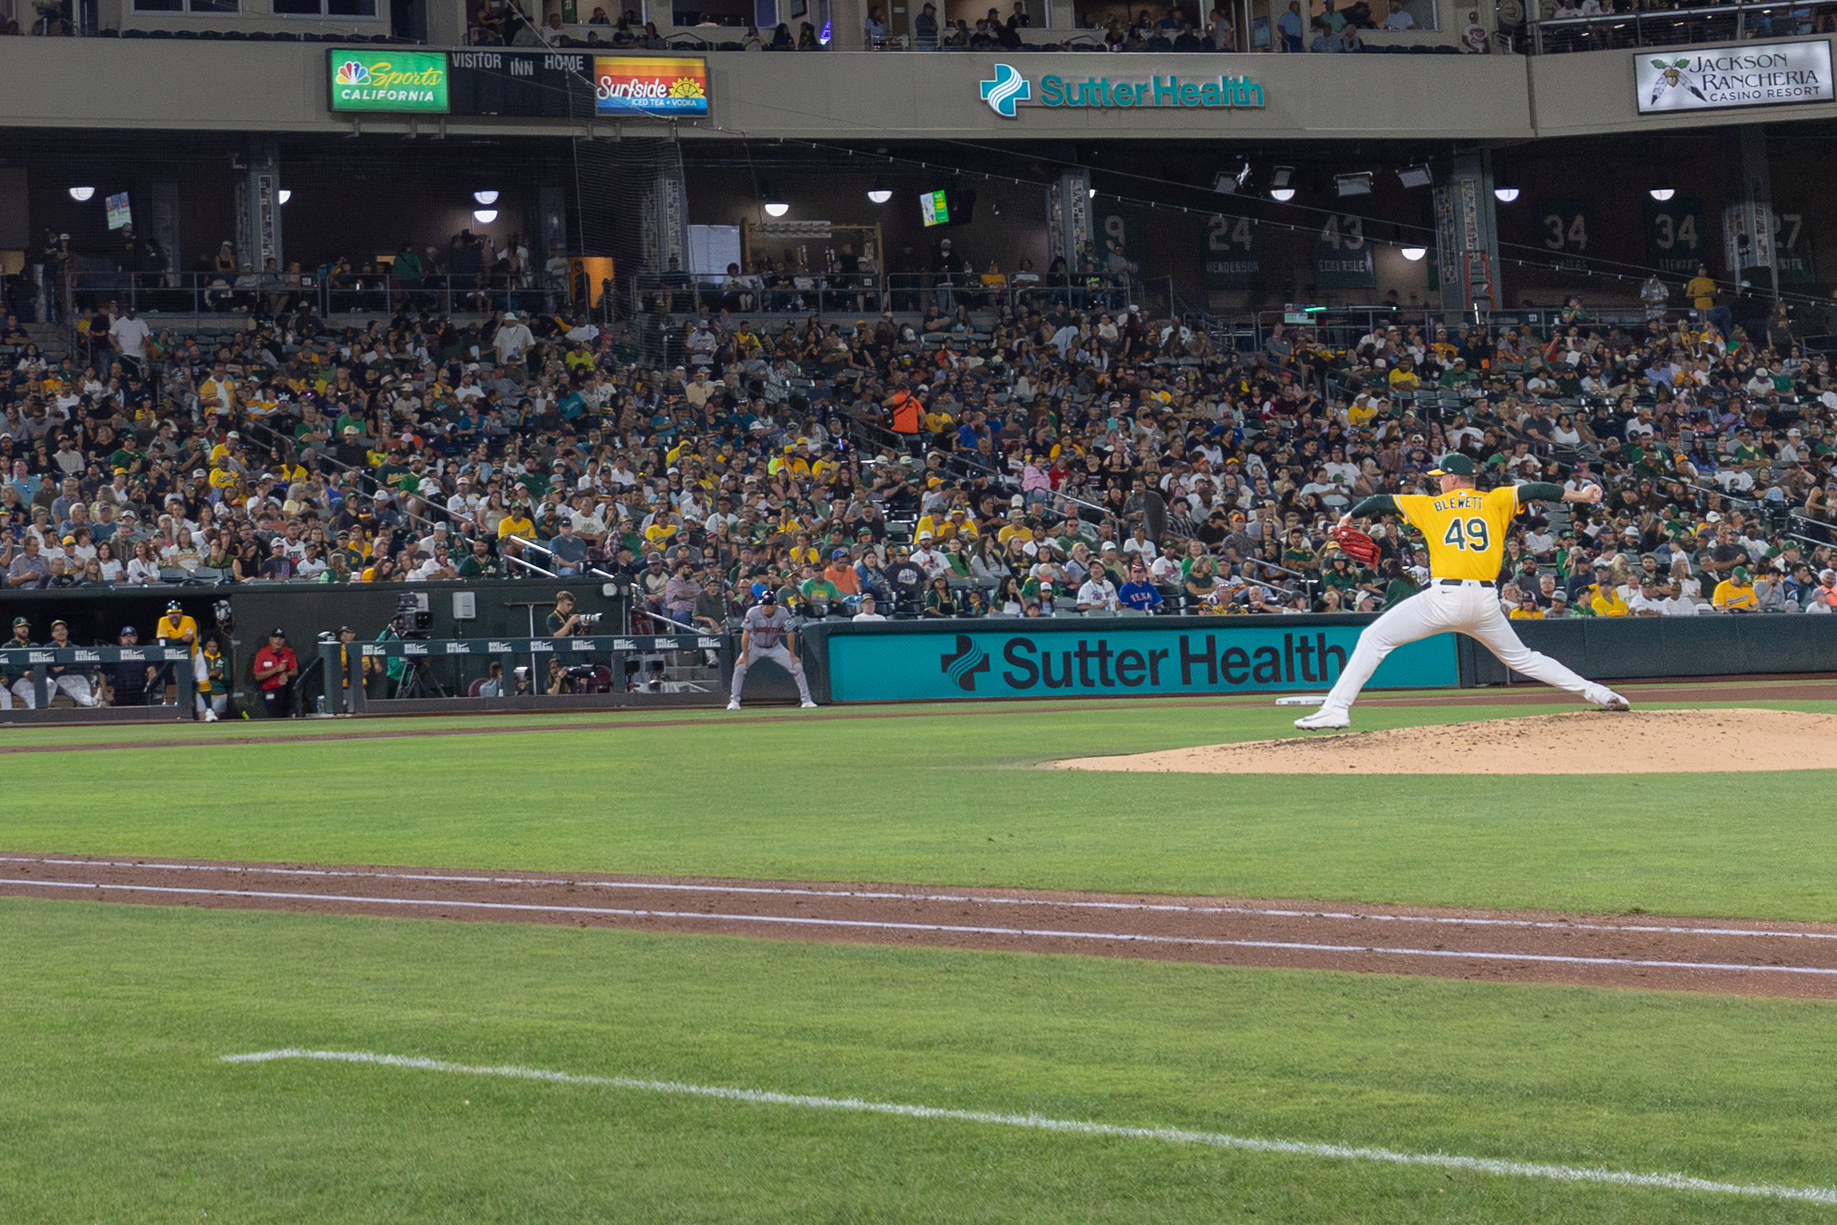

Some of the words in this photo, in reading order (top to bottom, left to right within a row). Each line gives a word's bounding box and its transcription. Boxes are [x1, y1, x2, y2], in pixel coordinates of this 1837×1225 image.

[451, 53, 502, 70] VISITOR
[510, 59, 534, 76] INN
[544, 55, 584, 71] HOME
[1689, 52, 1788, 73] JACKSON
[367, 61, 443, 90] Sports
[1702, 70, 1819, 91] RANCHERIA
[341, 89, 435, 102] CALIFORNIA
[597, 76, 667, 100] Surfside
[1039, 75, 1148, 107] Sutter
[1151, 75, 1264, 107] Health
[1710, 89, 1761, 102] CASINO
[1767, 86, 1821, 98] RESORT
[649, 98, 664, 107] TEA
[670, 99, 697, 107] VODKA
[1207, 215, 1254, 251] 24
[1321, 214, 1365, 250] 43
[1544, 213, 1589, 250] 34
[1655, 213, 1699, 250] 34
[1434, 494, 1485, 513] BLEWETT
[1443, 516, 1491, 553] 49
[1129, 591, 1153, 603] TEXA
[1003, 636, 1168, 690] Sutter
[1179, 632, 1348, 685] Health
